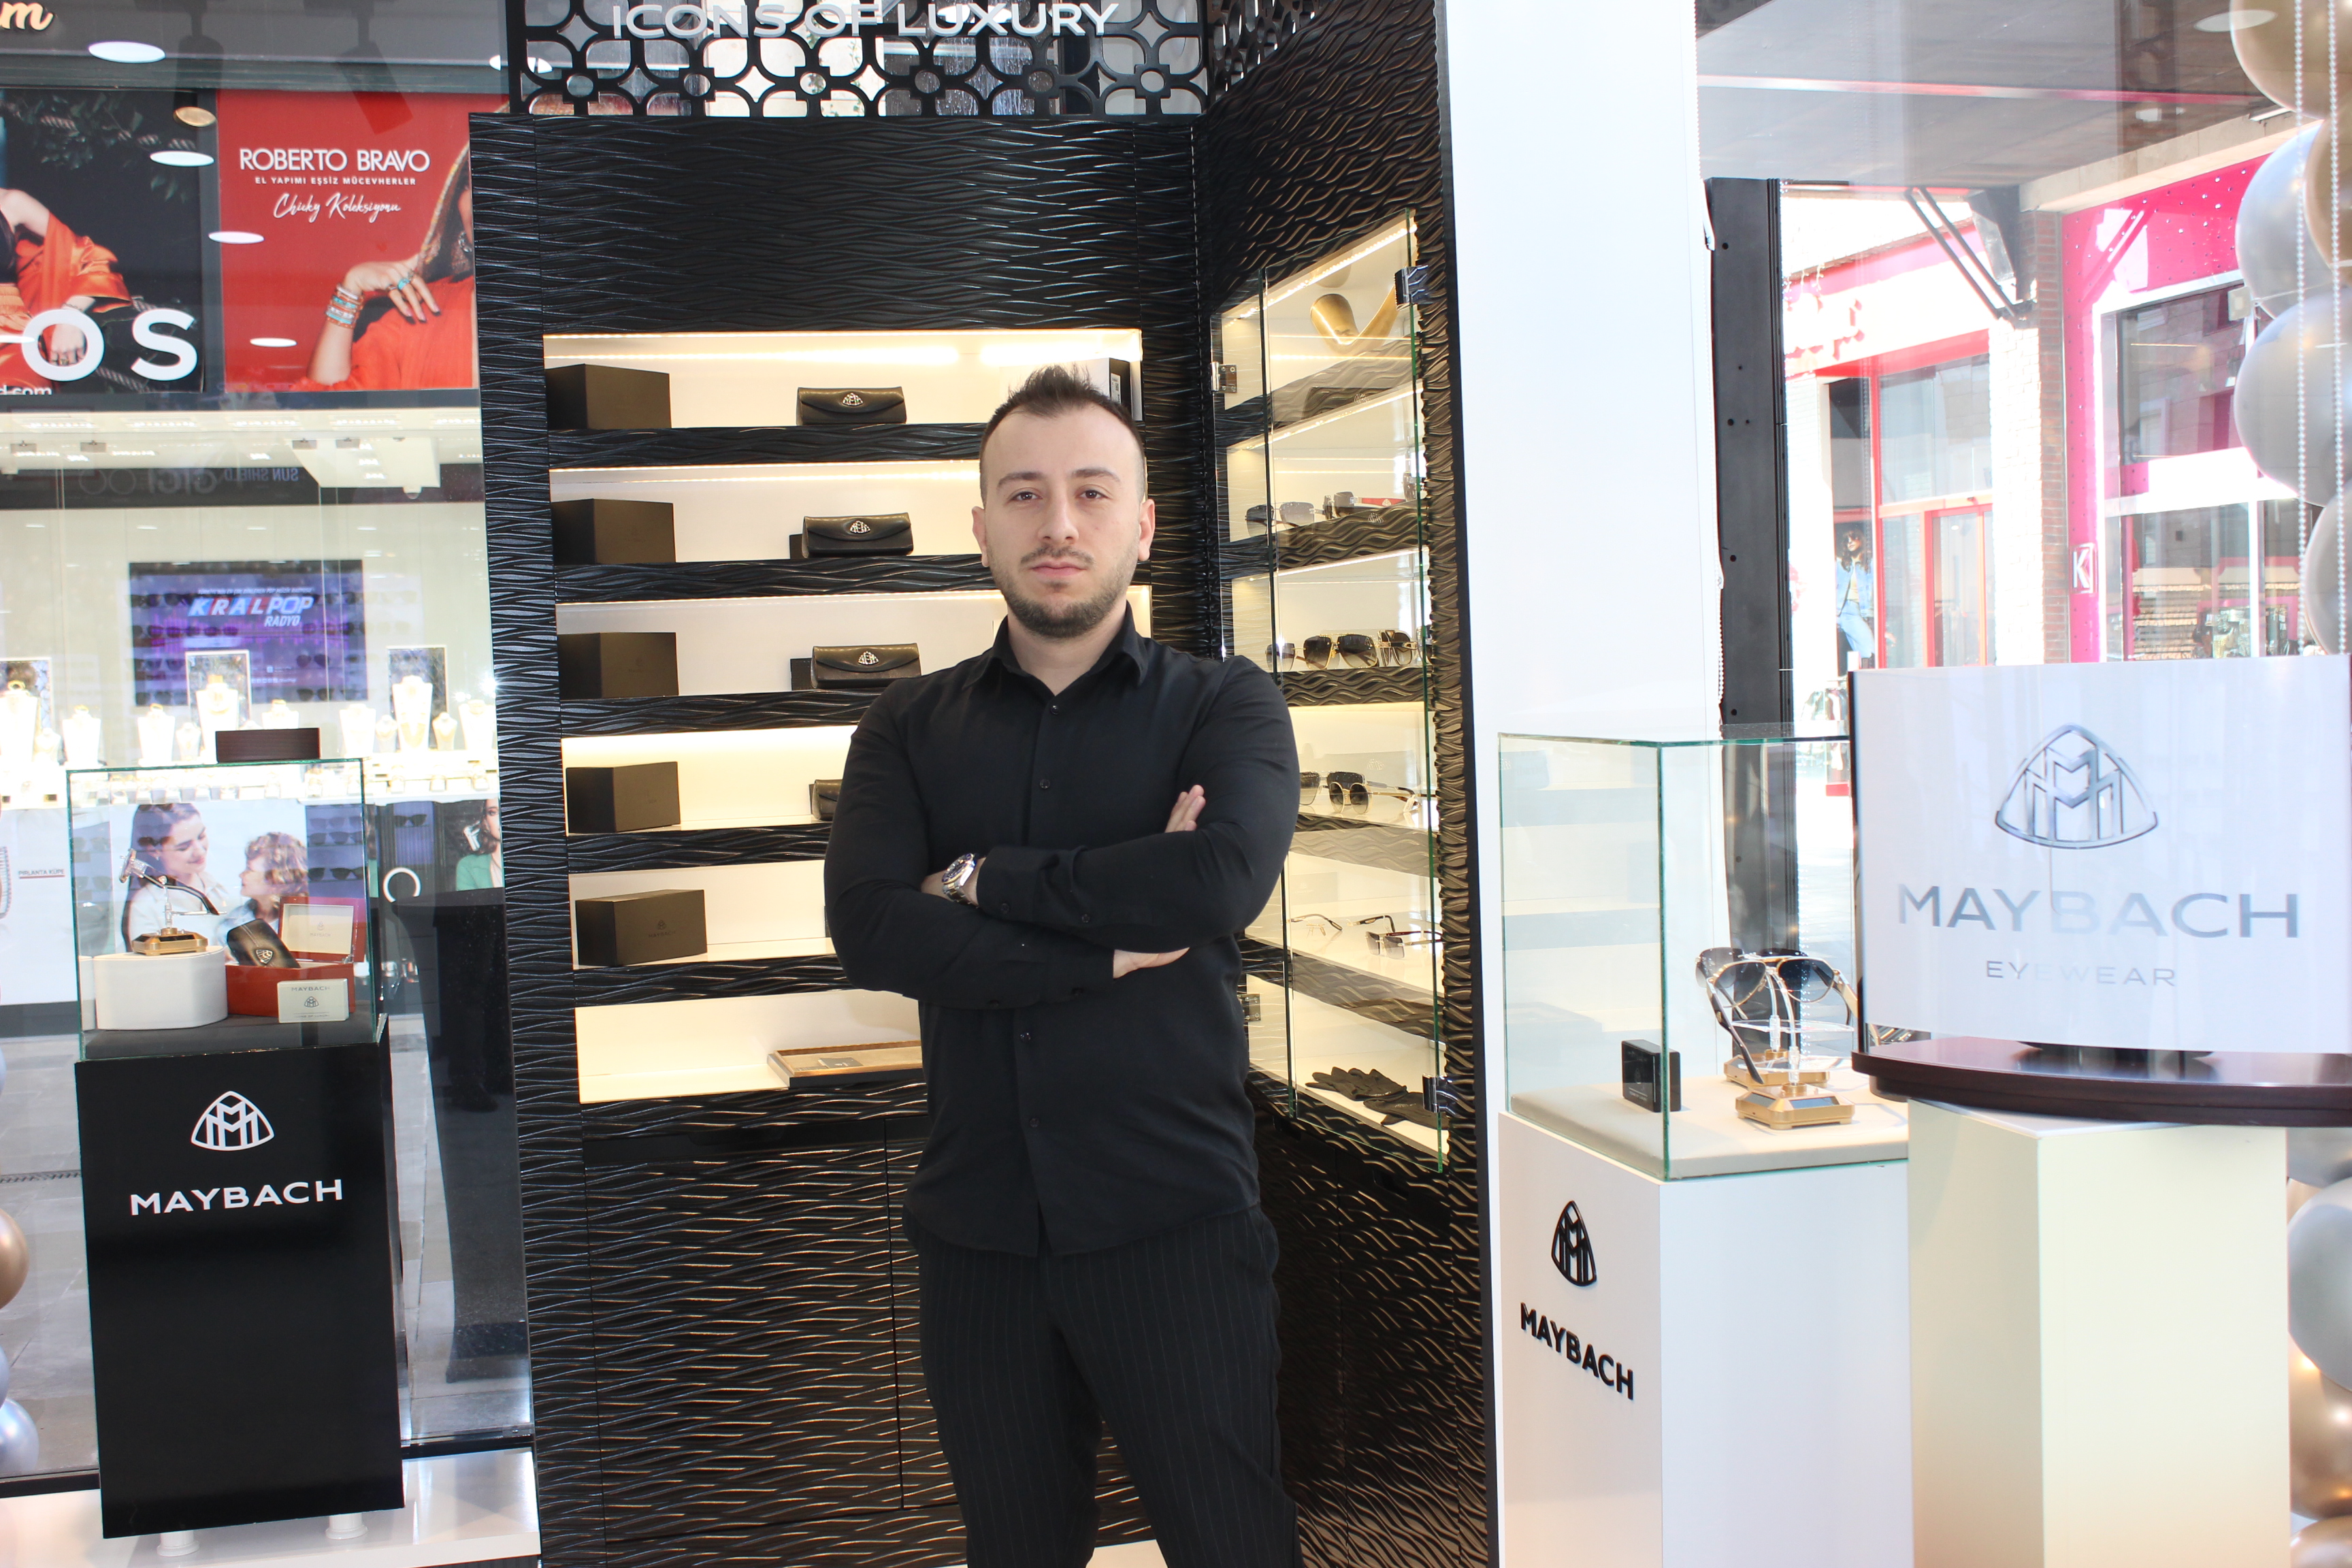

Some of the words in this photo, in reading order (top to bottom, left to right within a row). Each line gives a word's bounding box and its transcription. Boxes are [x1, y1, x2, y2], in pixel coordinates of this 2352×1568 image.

[612, 4, 787, 39] ICONS
[804, 3, 879, 37] OF
[898, 3, 1120, 36] LUXURY
[240, 148, 348, 171] ROBERTO
[357, 149, 430, 172] BRAVO
[311, 176, 338, 186] EŞSİZ
[343, 176, 416, 185] MÜCEVHERLER
[325, 192, 401, 223] Koleksiyonu
[189, 597, 265, 617] KRAL
[266, 596, 314, 615] POP
[265, 615, 301, 627] RADYO
[1897, 883, 2300, 938] MAYBACH
[1986, 959, 2176, 987] EYEWEAR
[130, 1179, 342, 1216] MAYBACH
[1520, 1302, 1633, 1401] MAYBACH
